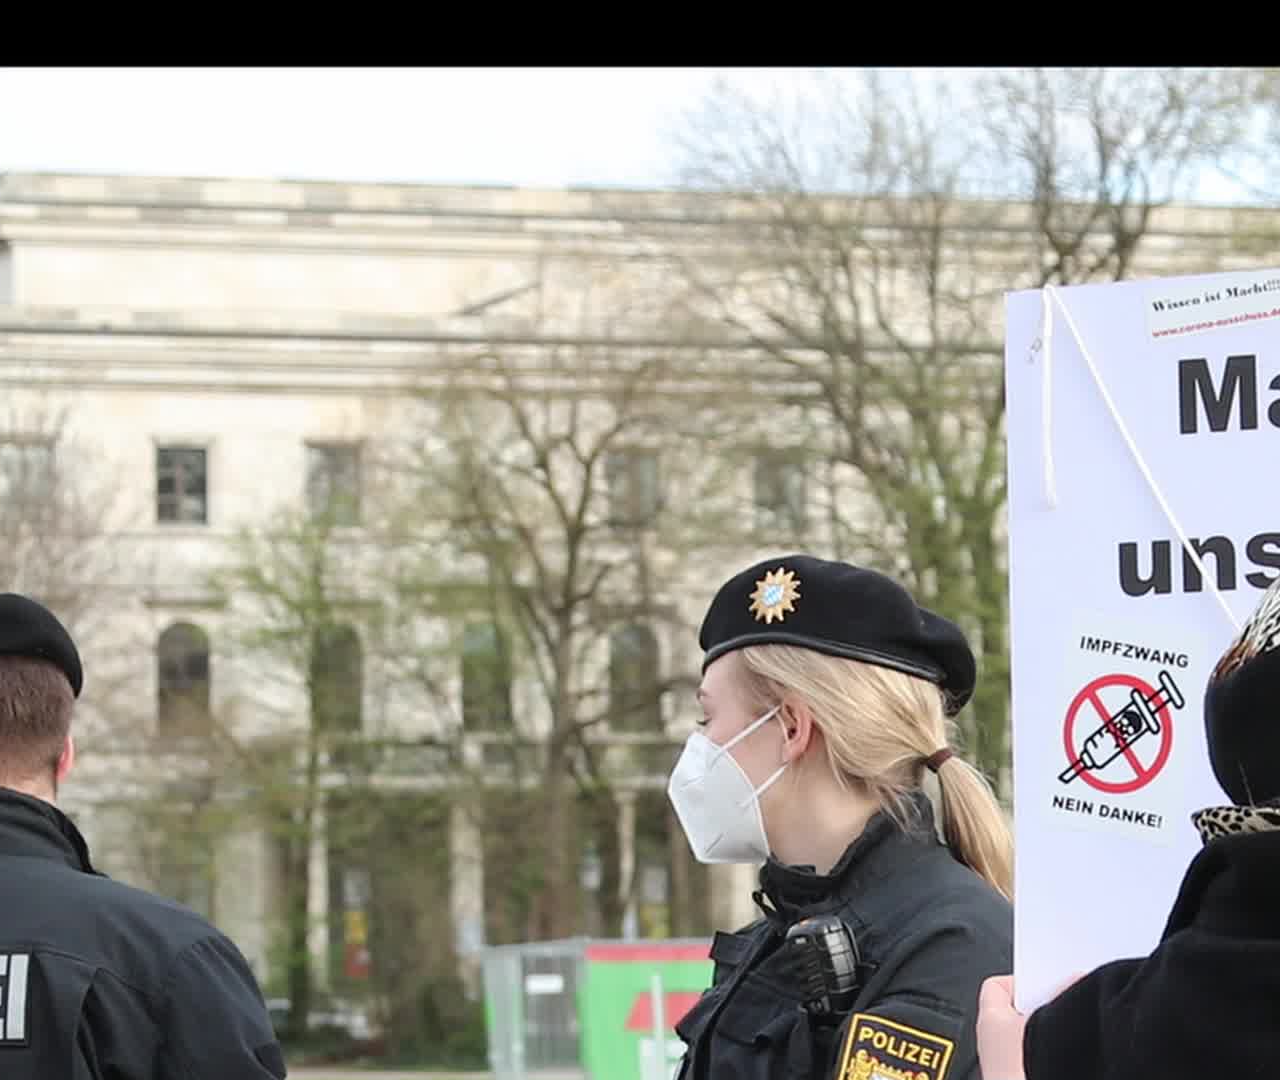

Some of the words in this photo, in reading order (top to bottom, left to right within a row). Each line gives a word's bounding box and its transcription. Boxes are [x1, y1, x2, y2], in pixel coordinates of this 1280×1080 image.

[1151, 297, 1201, 312] Wissen
[1204, 291, 1221, 303] ist
[1079, 635, 1189, 668] IMPFZWANG
[1052, 795, 1093, 815] NEIN
[1098, 803, 1163, 828] DANKE!
[858, 1026, 941, 1069] POLIZEI
